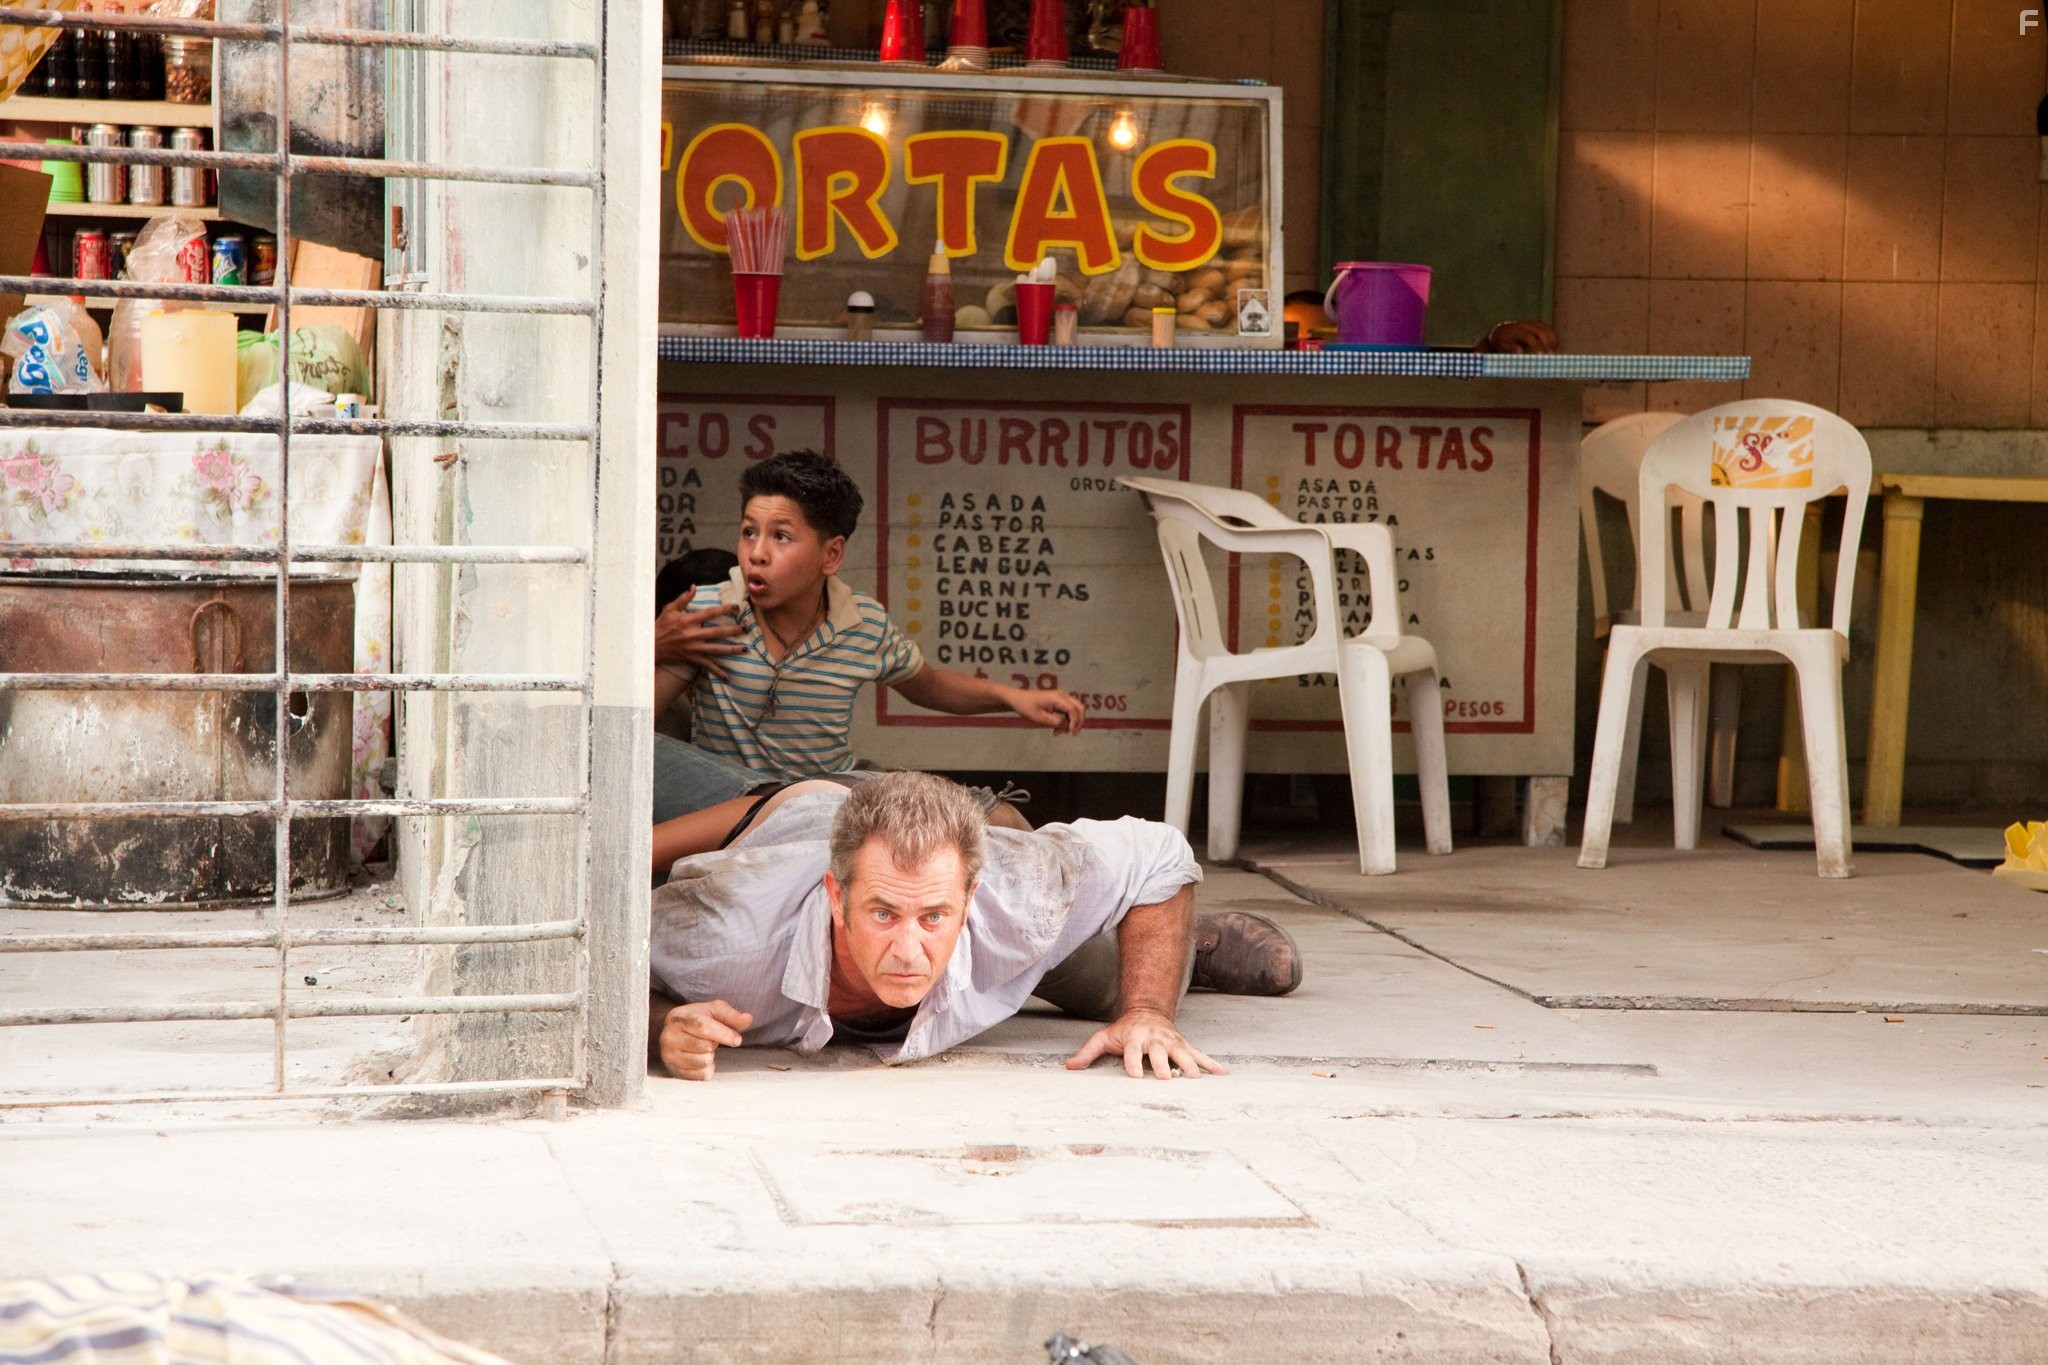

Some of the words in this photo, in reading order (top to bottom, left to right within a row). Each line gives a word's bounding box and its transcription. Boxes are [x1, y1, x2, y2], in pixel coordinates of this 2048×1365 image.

[661, 122, 1222, 275] ORTAS
[915, 416, 1179, 471] BURRITOS
[1293, 423, 1494, 472] TORTAS
[1298, 478, 1377, 494] ASADA
[940, 492, 1046, 512] ASADA
[1297, 495, 1379, 511] PASTOR
[939, 512, 1044, 533] PASTOR
[933, 534, 1054, 555] CABEZA
[936, 555, 1051, 576] LENGUA
[936, 578, 1089, 600] CARNITAS
[939, 600, 1031, 620] BUCHE
[938, 620, 1025, 641] POLLO
[937, 645, 1071, 665] CHORIZO
[1443, 699, 1505, 717] PESOS
